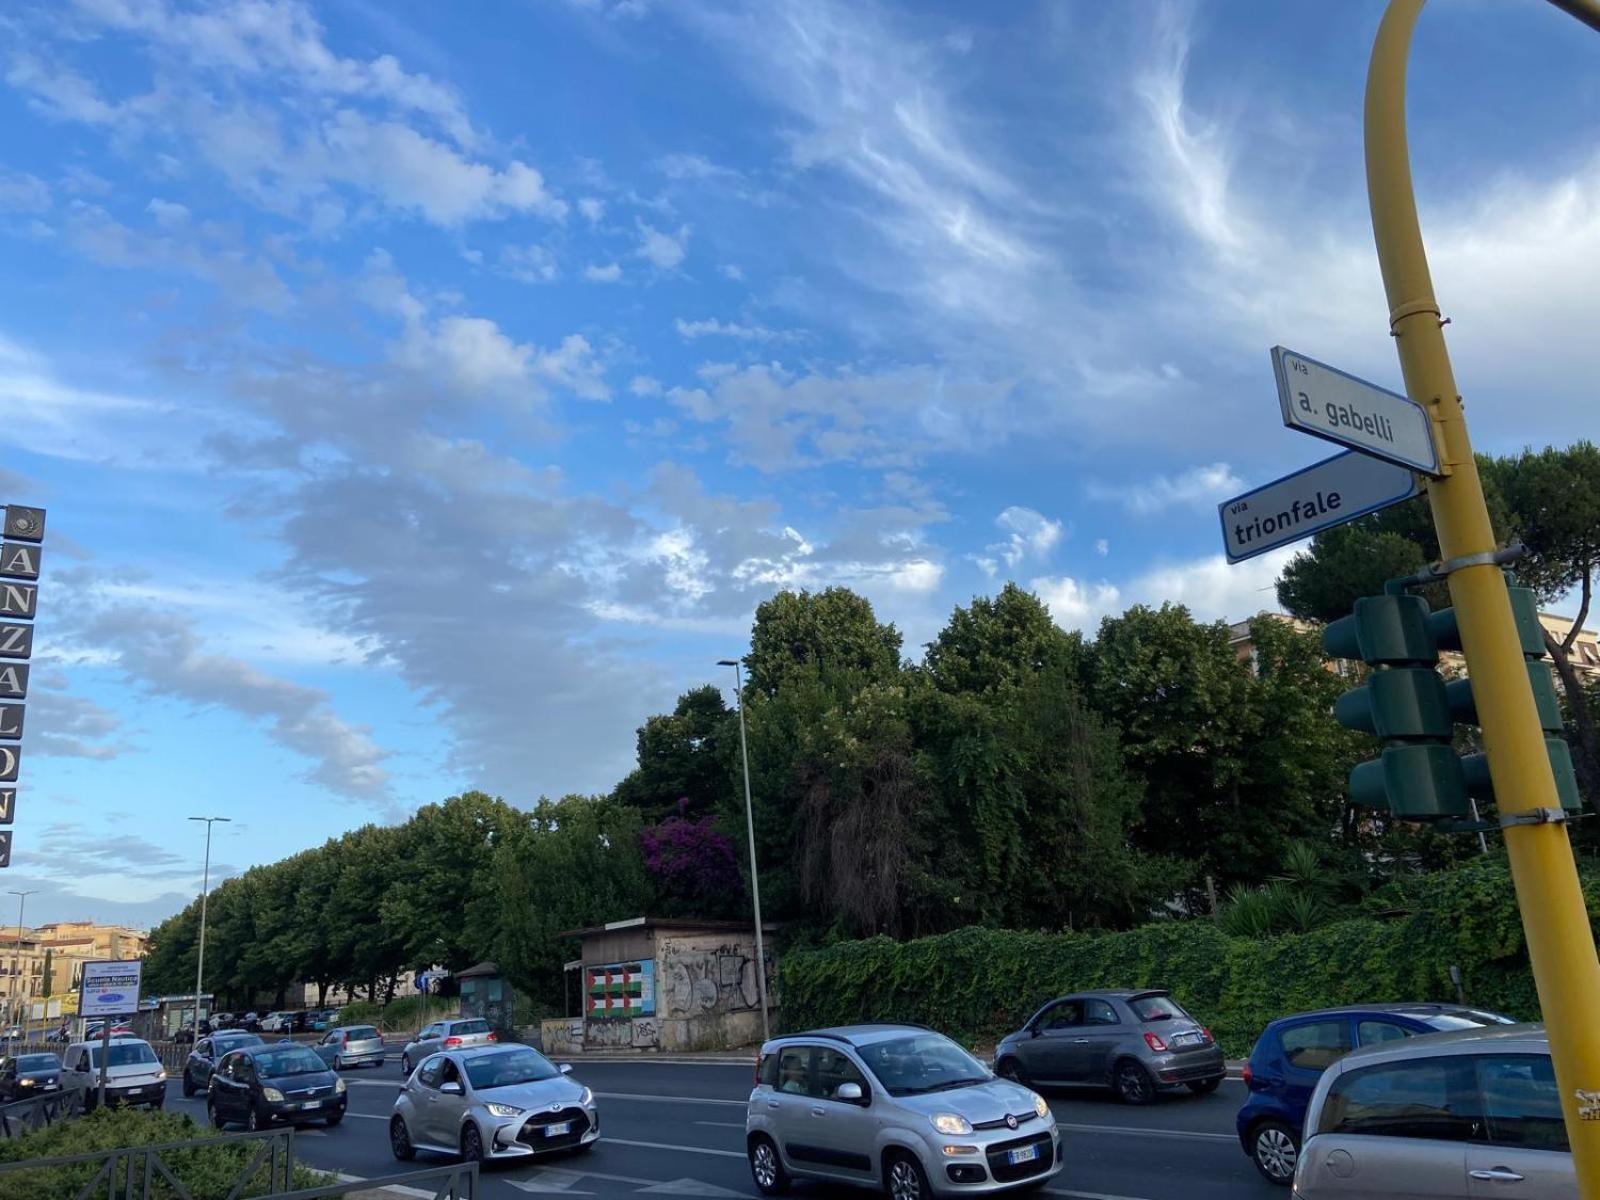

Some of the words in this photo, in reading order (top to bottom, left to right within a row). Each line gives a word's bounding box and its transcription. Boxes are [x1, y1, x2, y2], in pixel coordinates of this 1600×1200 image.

[1292, 359, 1308, 375] via
[1298, 391, 1318, 415] a.
[1325, 402, 1394, 443] gabelli
[1230, 500, 1248, 515] via
[1234, 491, 1342, 545] trionfale
[0, 548, 37, 858] ANZALO
